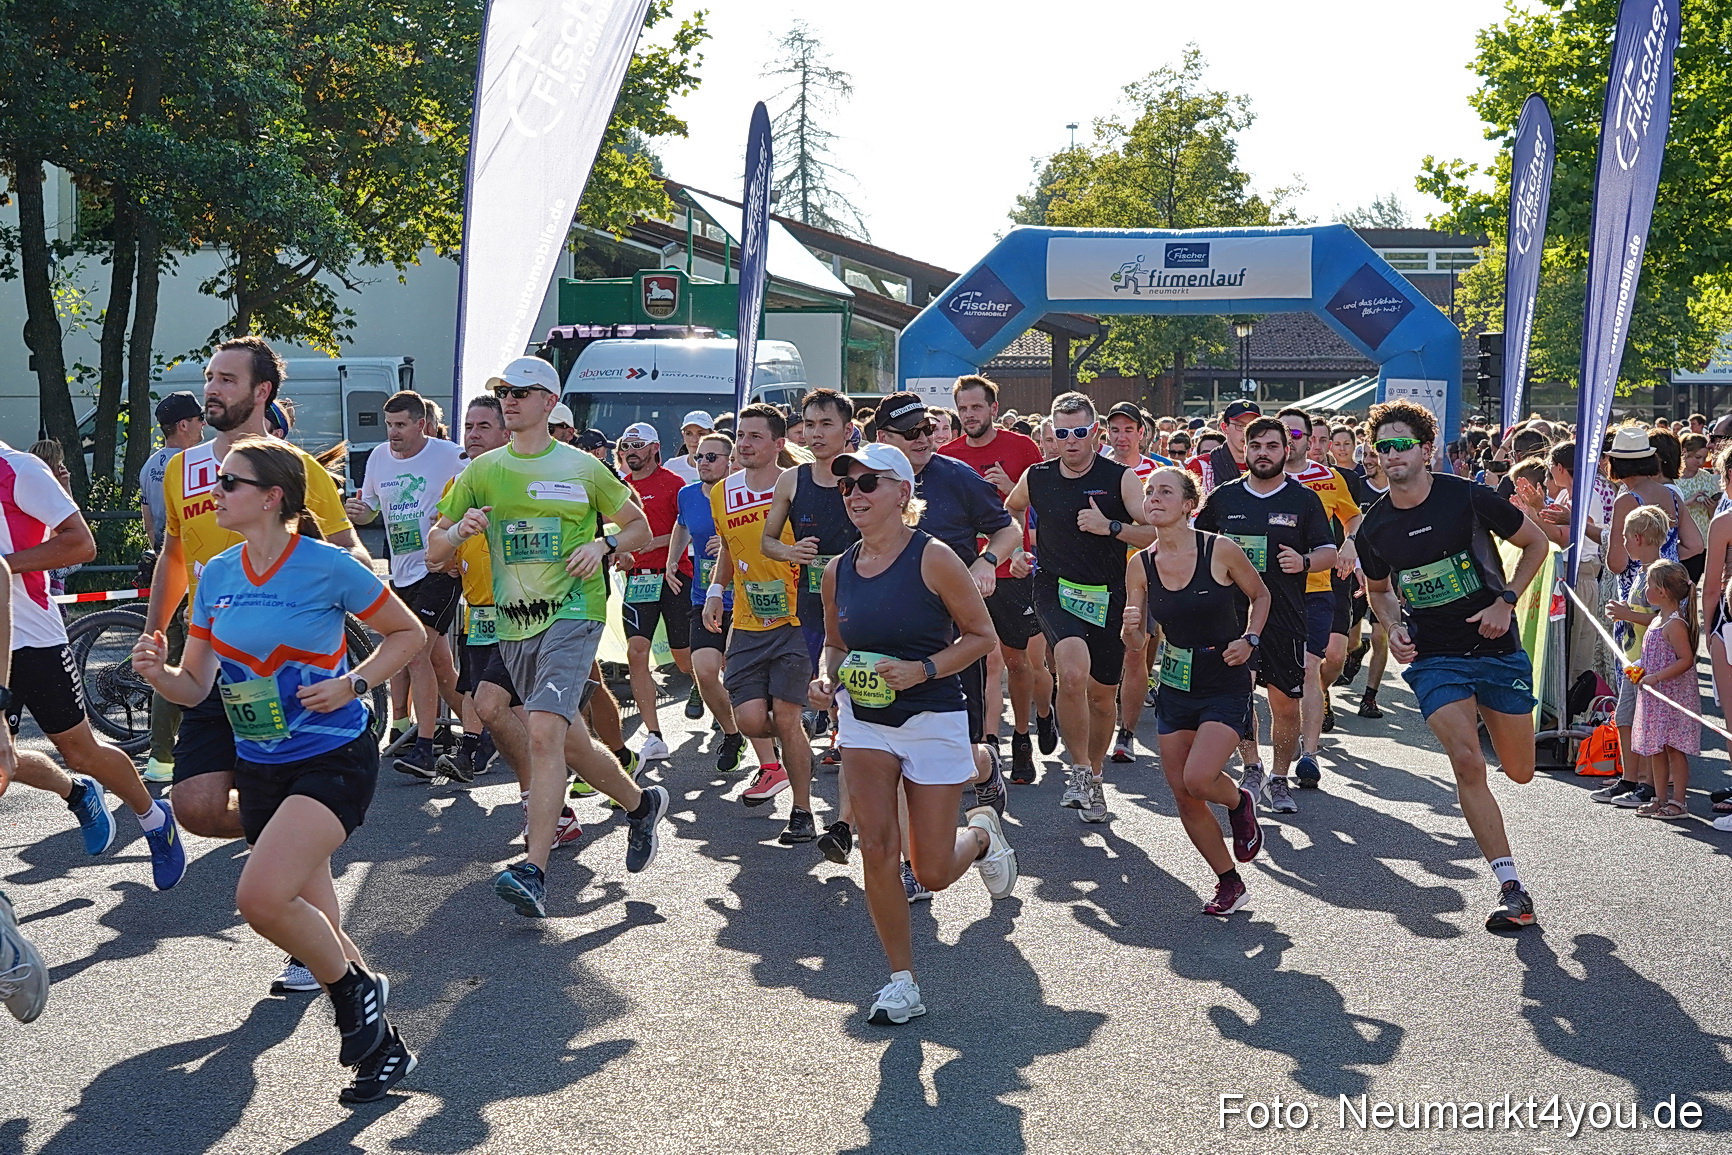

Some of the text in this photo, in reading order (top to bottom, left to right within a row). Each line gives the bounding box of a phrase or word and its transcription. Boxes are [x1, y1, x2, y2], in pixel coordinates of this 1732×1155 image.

[531, 0, 593, 107] Fisch
[569, 0, 617, 100] AUTOMOB
[1642, 10, 1669, 137] AUTOMOBILE
[1521, 124, 1544, 235] Fischer
[1173, 252, 1207, 260] Fischer
[1148, 268, 1247, 287] firmenlauf
[959, 300, 1012, 312] Fischer
[1343, 301, 1357, 310] und
[1358, 298, 1373, 307] das
[1511, 296, 1534, 426] .fischer-automobile.de
[579, 368, 624, 379] abavent
[183, 499, 217, 520] MA
[389, 500, 420, 511] Laufend
[727, 512, 760, 529] MAX
[394, 532, 411, 544] 357
[512, 533, 549, 550] 1141
[634, 584, 657, 594] 1705
[1414, 577, 1446, 595] 284
[750, 594, 780, 607] 1654
[1431, 590, 1451, 599] Patrick
[1070, 598, 1095, 614] 778
[477, 620, 495, 634] 158
[849, 670, 879, 690] 495
[863, 690, 885, 699] Kerstin
[232, 701, 284, 730] 16 2022
